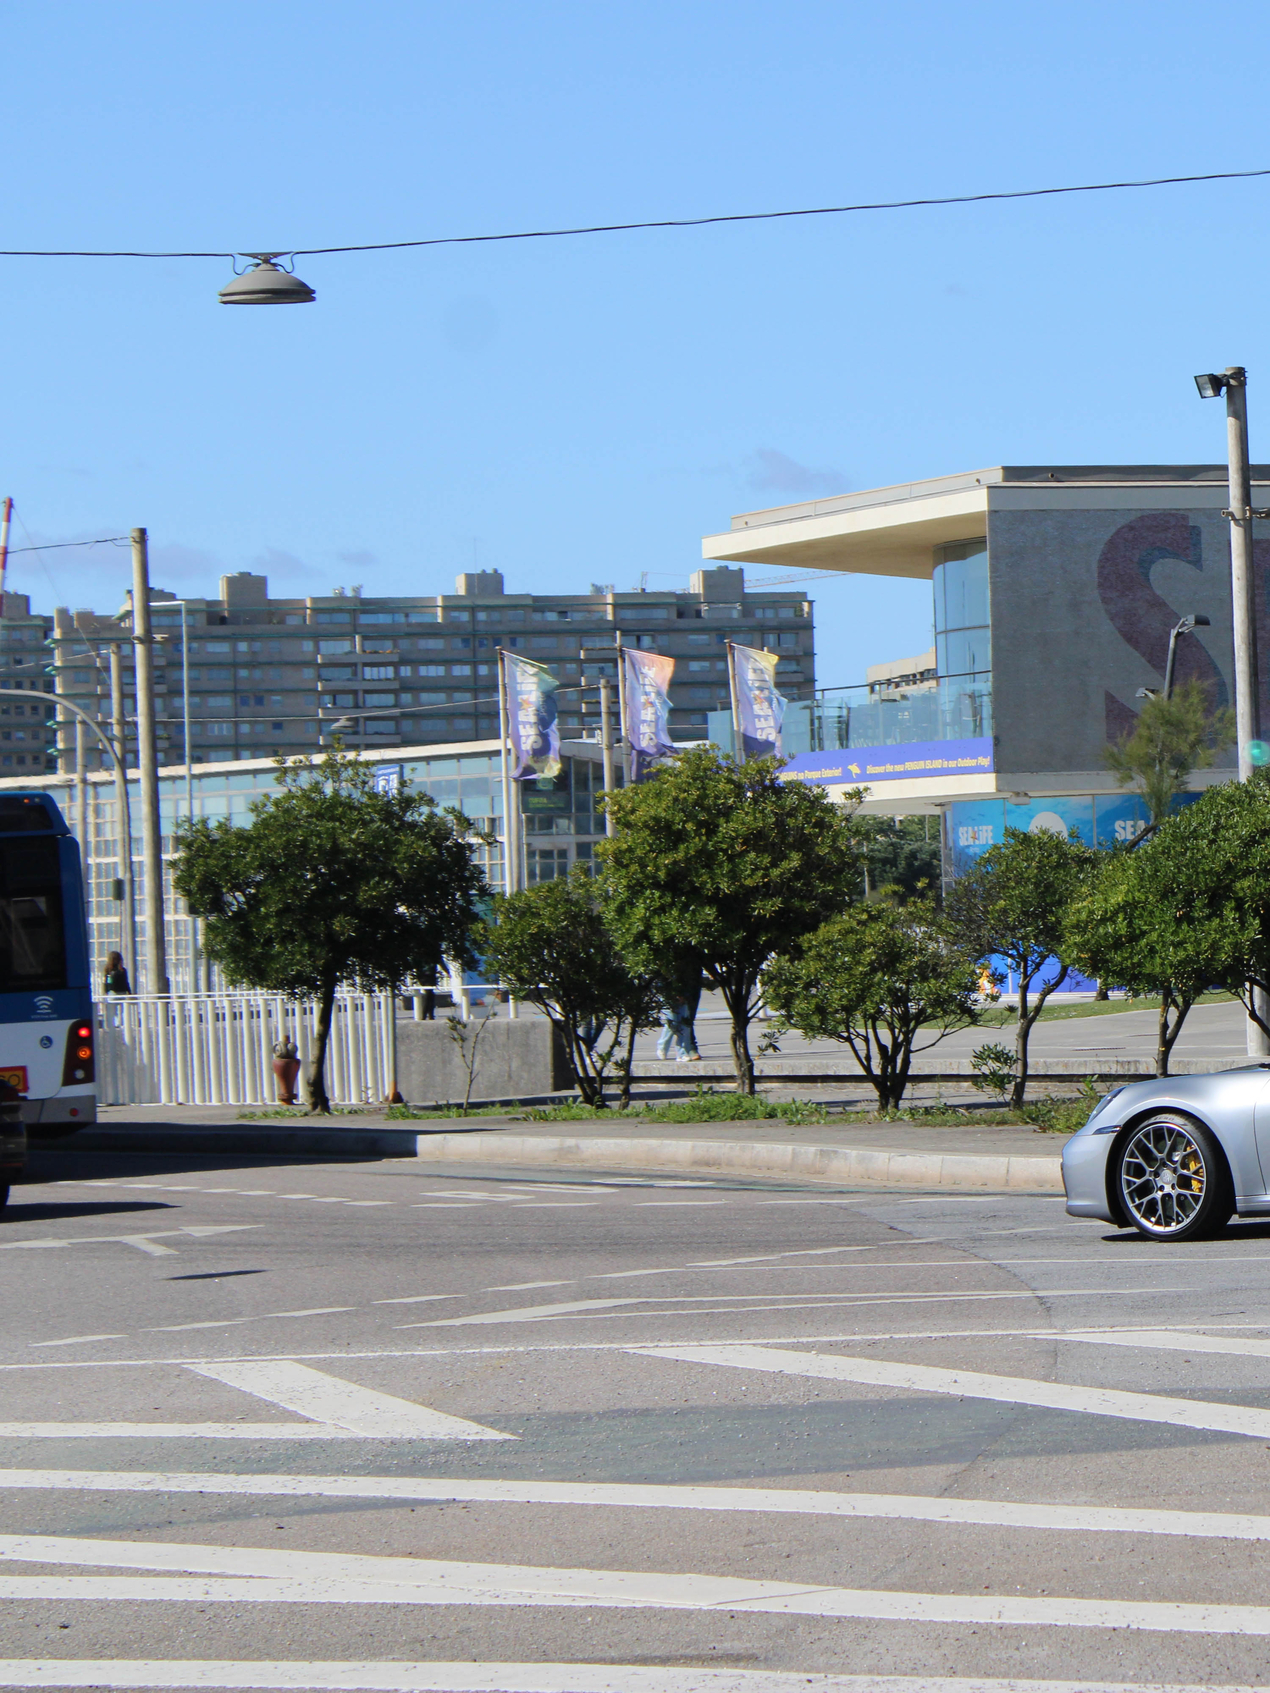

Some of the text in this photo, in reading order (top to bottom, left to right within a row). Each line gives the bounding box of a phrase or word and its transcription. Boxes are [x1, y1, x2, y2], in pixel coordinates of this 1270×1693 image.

[518, 707, 543, 751] SEA
[639, 706, 659, 748] SEA
[752, 702, 777, 743] SEA
[905, 761, 924, 770] PENGUIN
[925, 760, 942, 768] ISLAND
[958, 826, 974, 846] SEA
